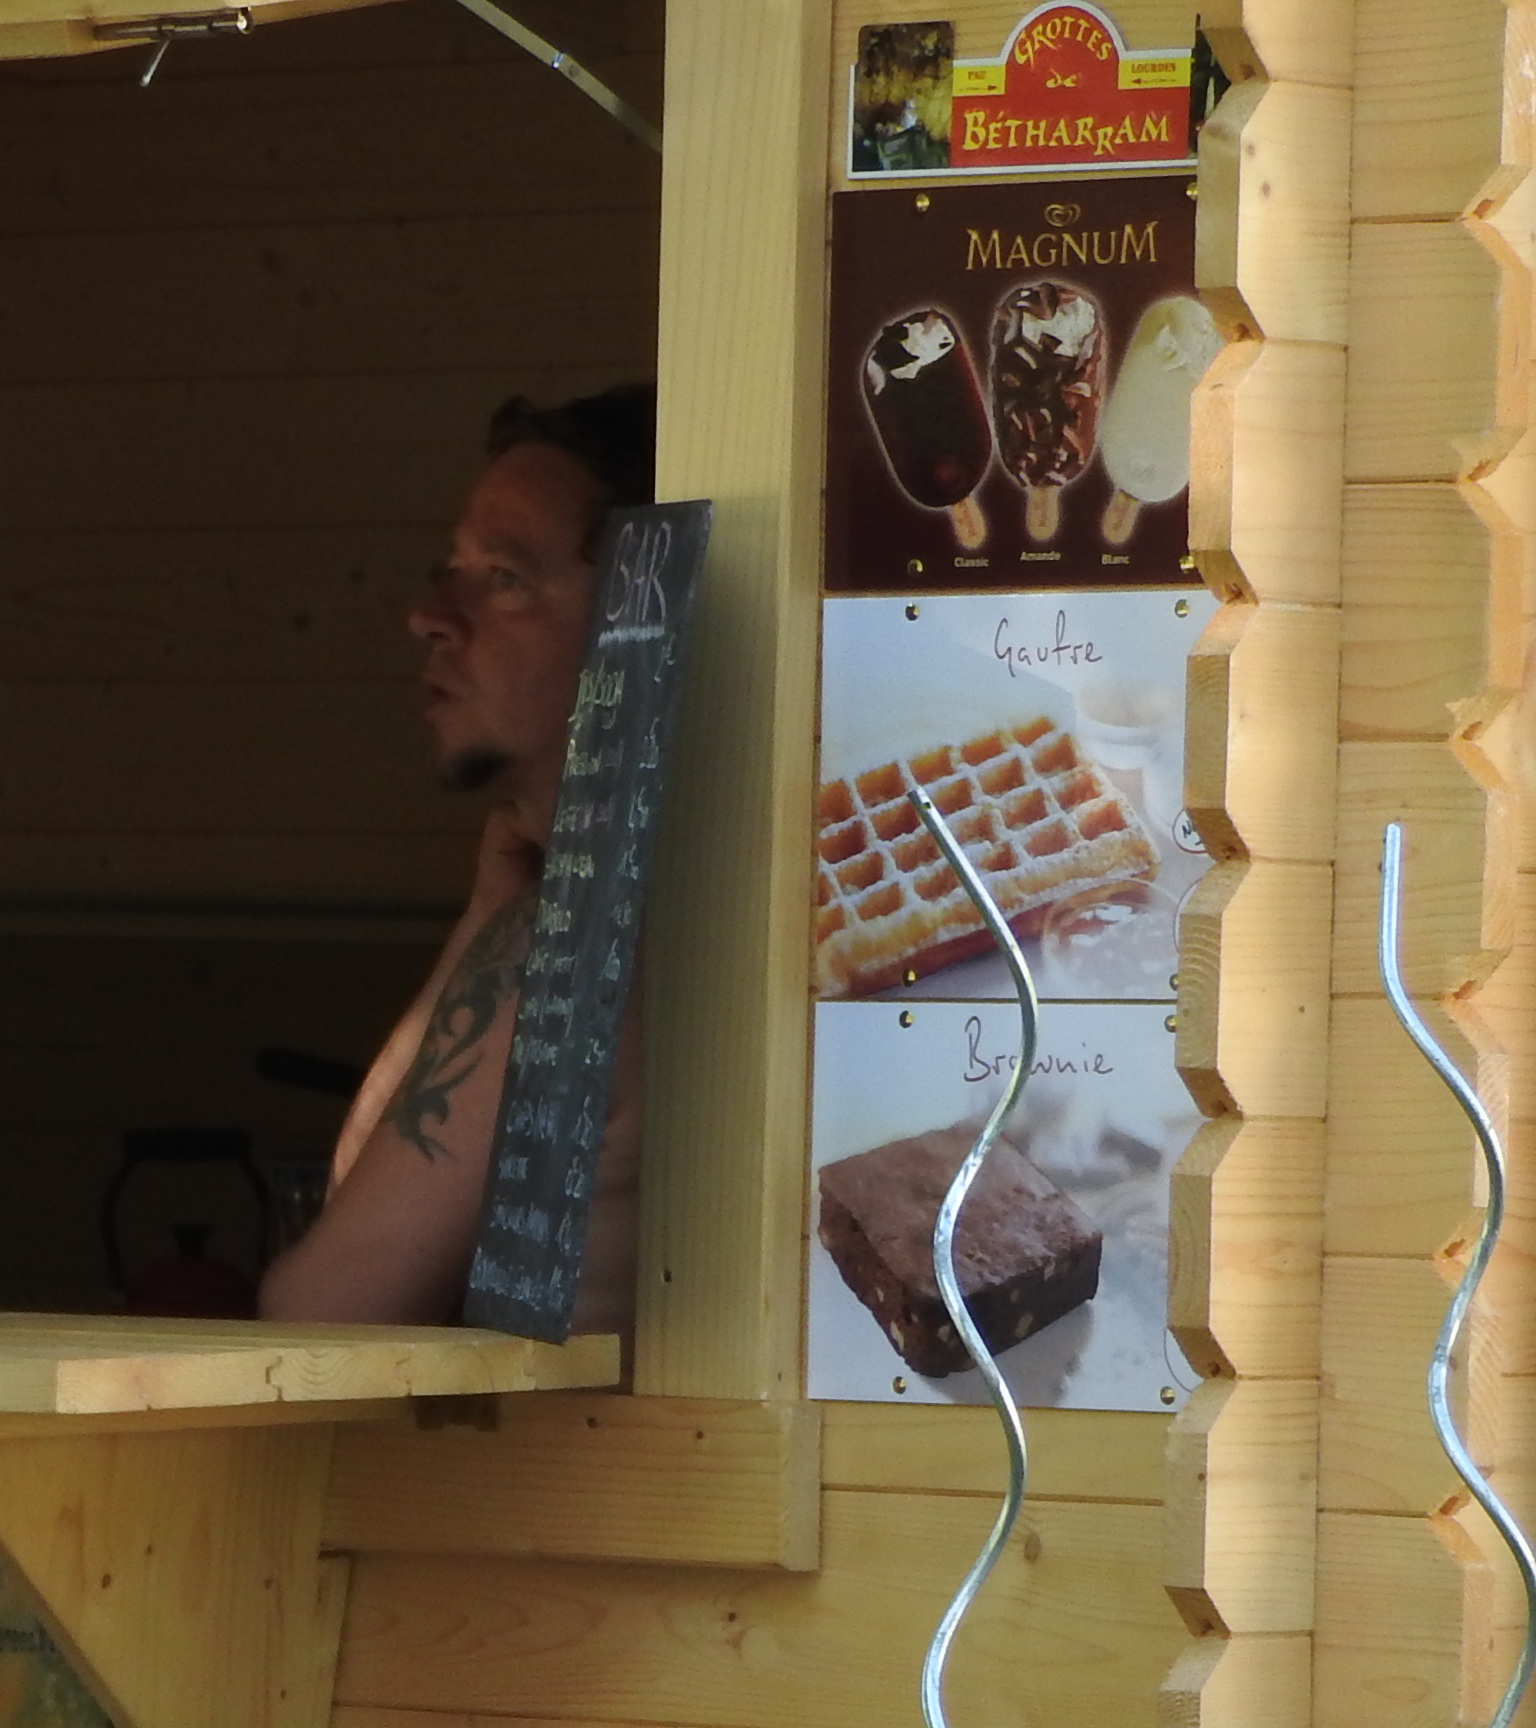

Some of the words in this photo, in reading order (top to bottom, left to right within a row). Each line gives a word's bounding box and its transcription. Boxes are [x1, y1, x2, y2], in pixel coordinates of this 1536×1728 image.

[1014, 16, 1112, 70] GROTTES
[1045, 68, 1077, 88] de
[1131, 62, 1176, 74] LOURDES
[961, 110, 1171, 156] BÉTHARRAM
[965, 220, 1159, 270] MAGNUM
[954, 557, 990, 568] Classic
[1020, 551, 1062, 562] Amande
[1101, 554, 1131, 565] Blanc
[994, 609, 1104, 678] Gaufre
[963, 1015, 1114, 1083] Brownie
